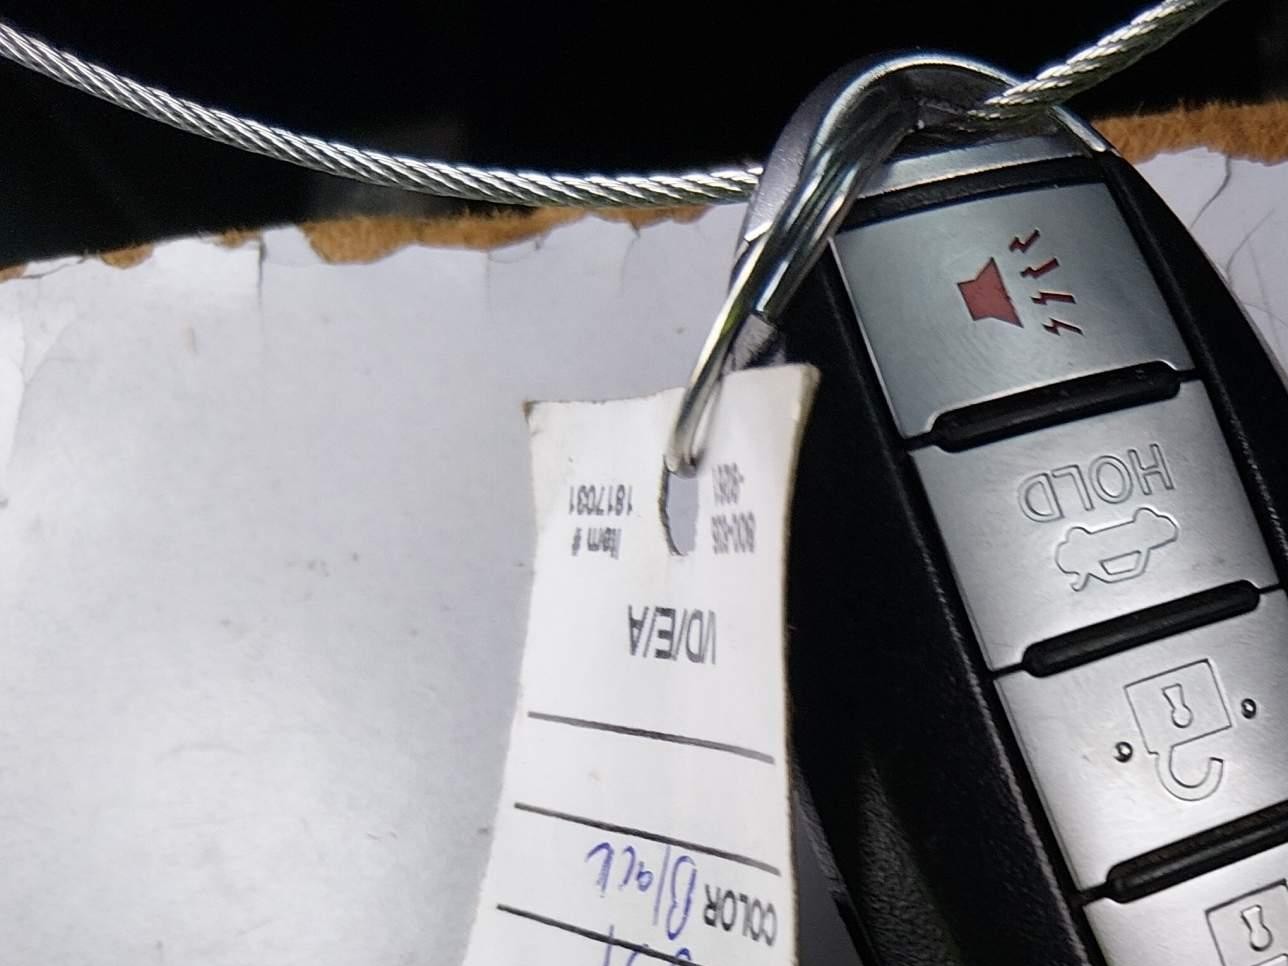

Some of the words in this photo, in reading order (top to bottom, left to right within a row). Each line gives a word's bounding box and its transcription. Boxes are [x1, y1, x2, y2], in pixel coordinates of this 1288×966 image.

[1017, 443, 1175, 523] HOLD
[587, 527, 622, 560] Item
[585, 842, 697, 940] Black
[703, 883, 777, 946] COLOR
